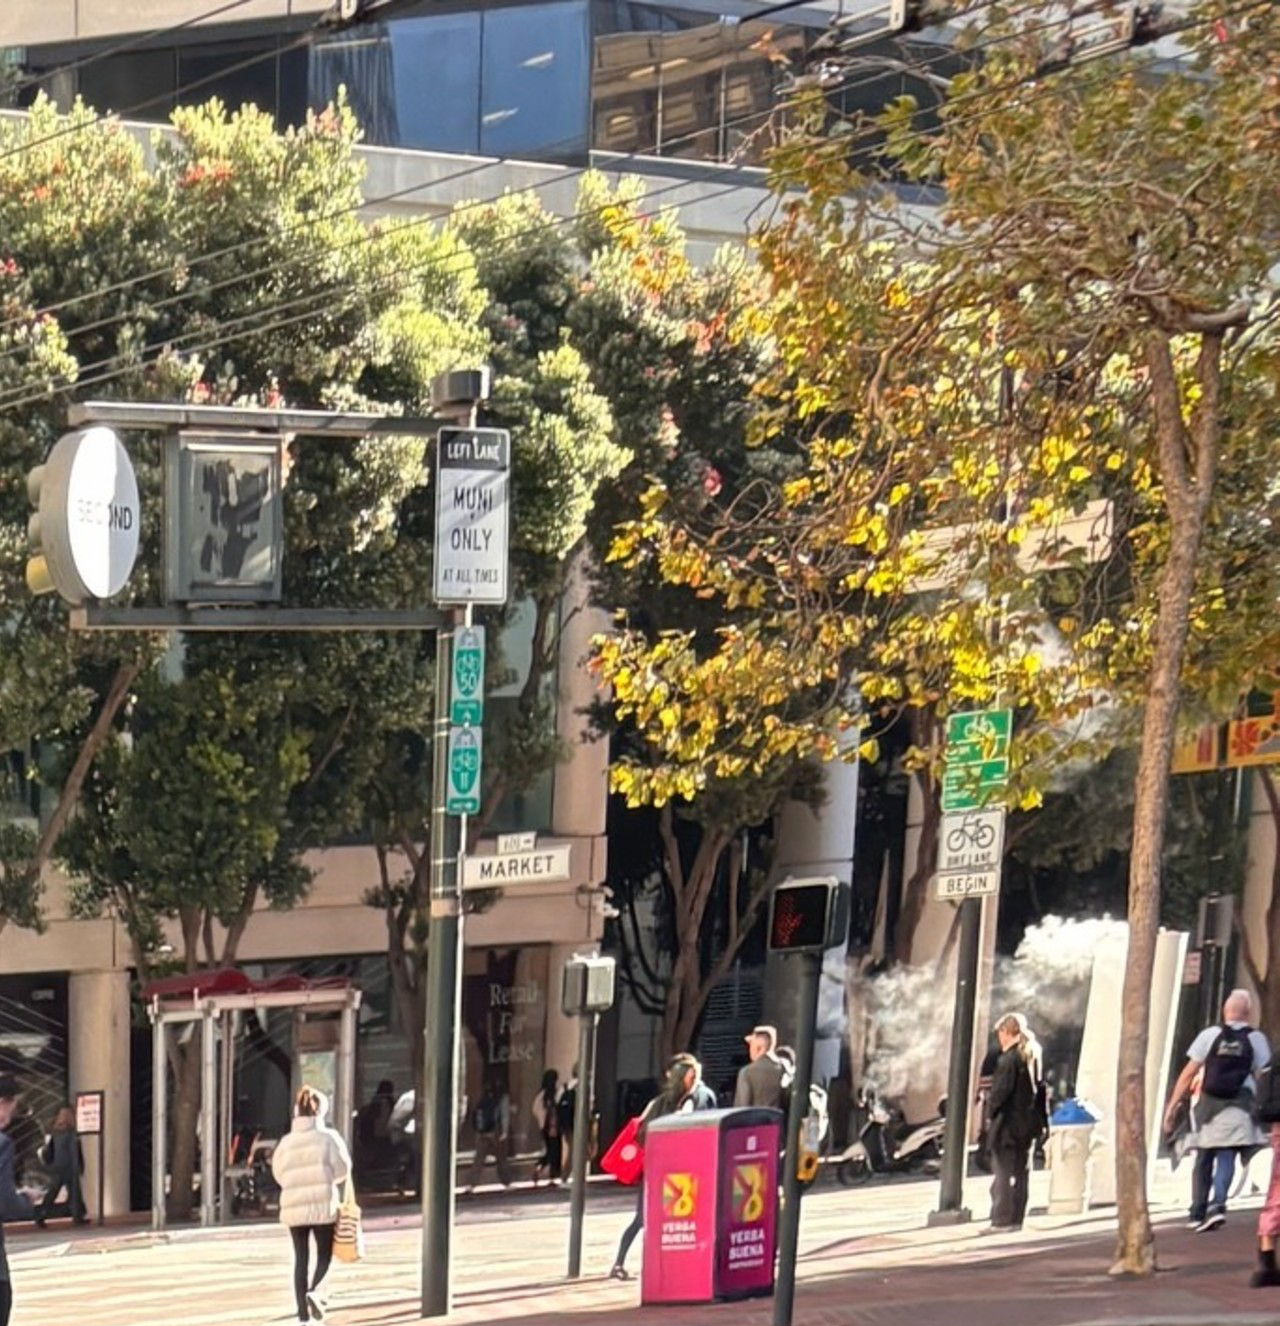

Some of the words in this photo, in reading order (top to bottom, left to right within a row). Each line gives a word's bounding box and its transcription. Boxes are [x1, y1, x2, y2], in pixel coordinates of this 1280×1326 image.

[453, 486, 493, 512] MUNI
[451, 527, 492, 551] ONLY
[480, 855, 554, 879] MARKET
[946, 876, 989, 893] BEGIN
